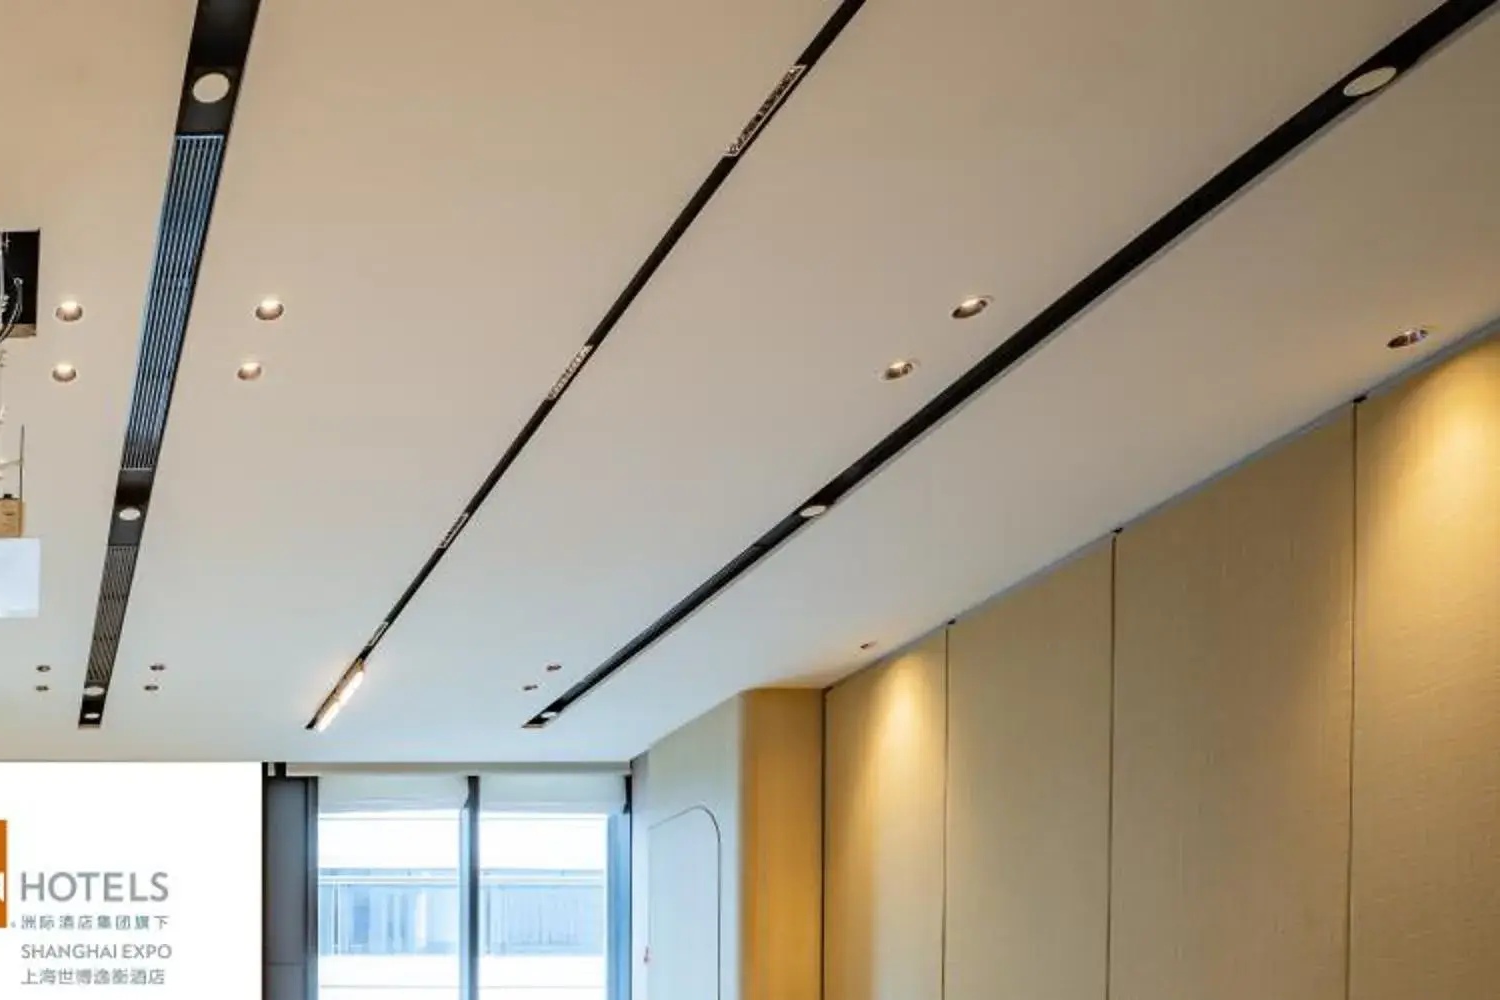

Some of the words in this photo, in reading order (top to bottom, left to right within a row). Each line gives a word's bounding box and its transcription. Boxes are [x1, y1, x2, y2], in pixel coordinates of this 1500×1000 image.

[21, 872, 169, 902] HOTELS
[21, 944, 117, 959] SHANGHAI
[122, 944, 172, 959] EXPO
